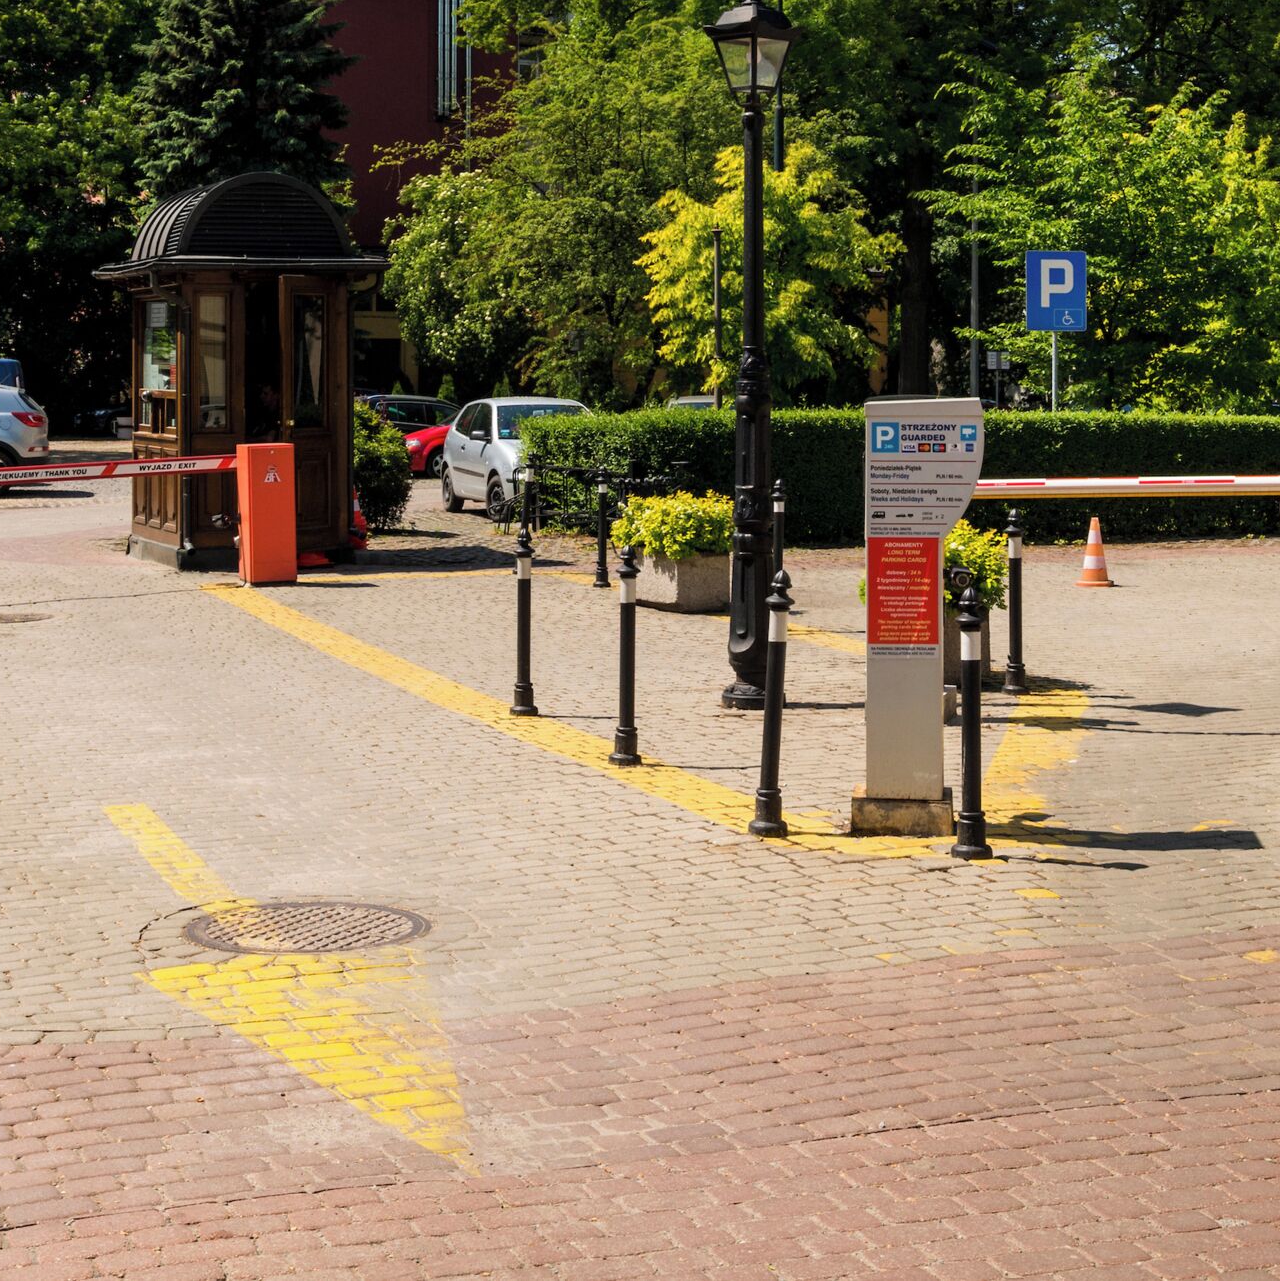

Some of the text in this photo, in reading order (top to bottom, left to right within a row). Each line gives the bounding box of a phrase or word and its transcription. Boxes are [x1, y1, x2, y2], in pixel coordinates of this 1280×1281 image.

[1041, 259, 1074, 307] P
[876, 426, 894, 449] P
[901, 423, 956, 431] STRZEŻONY
